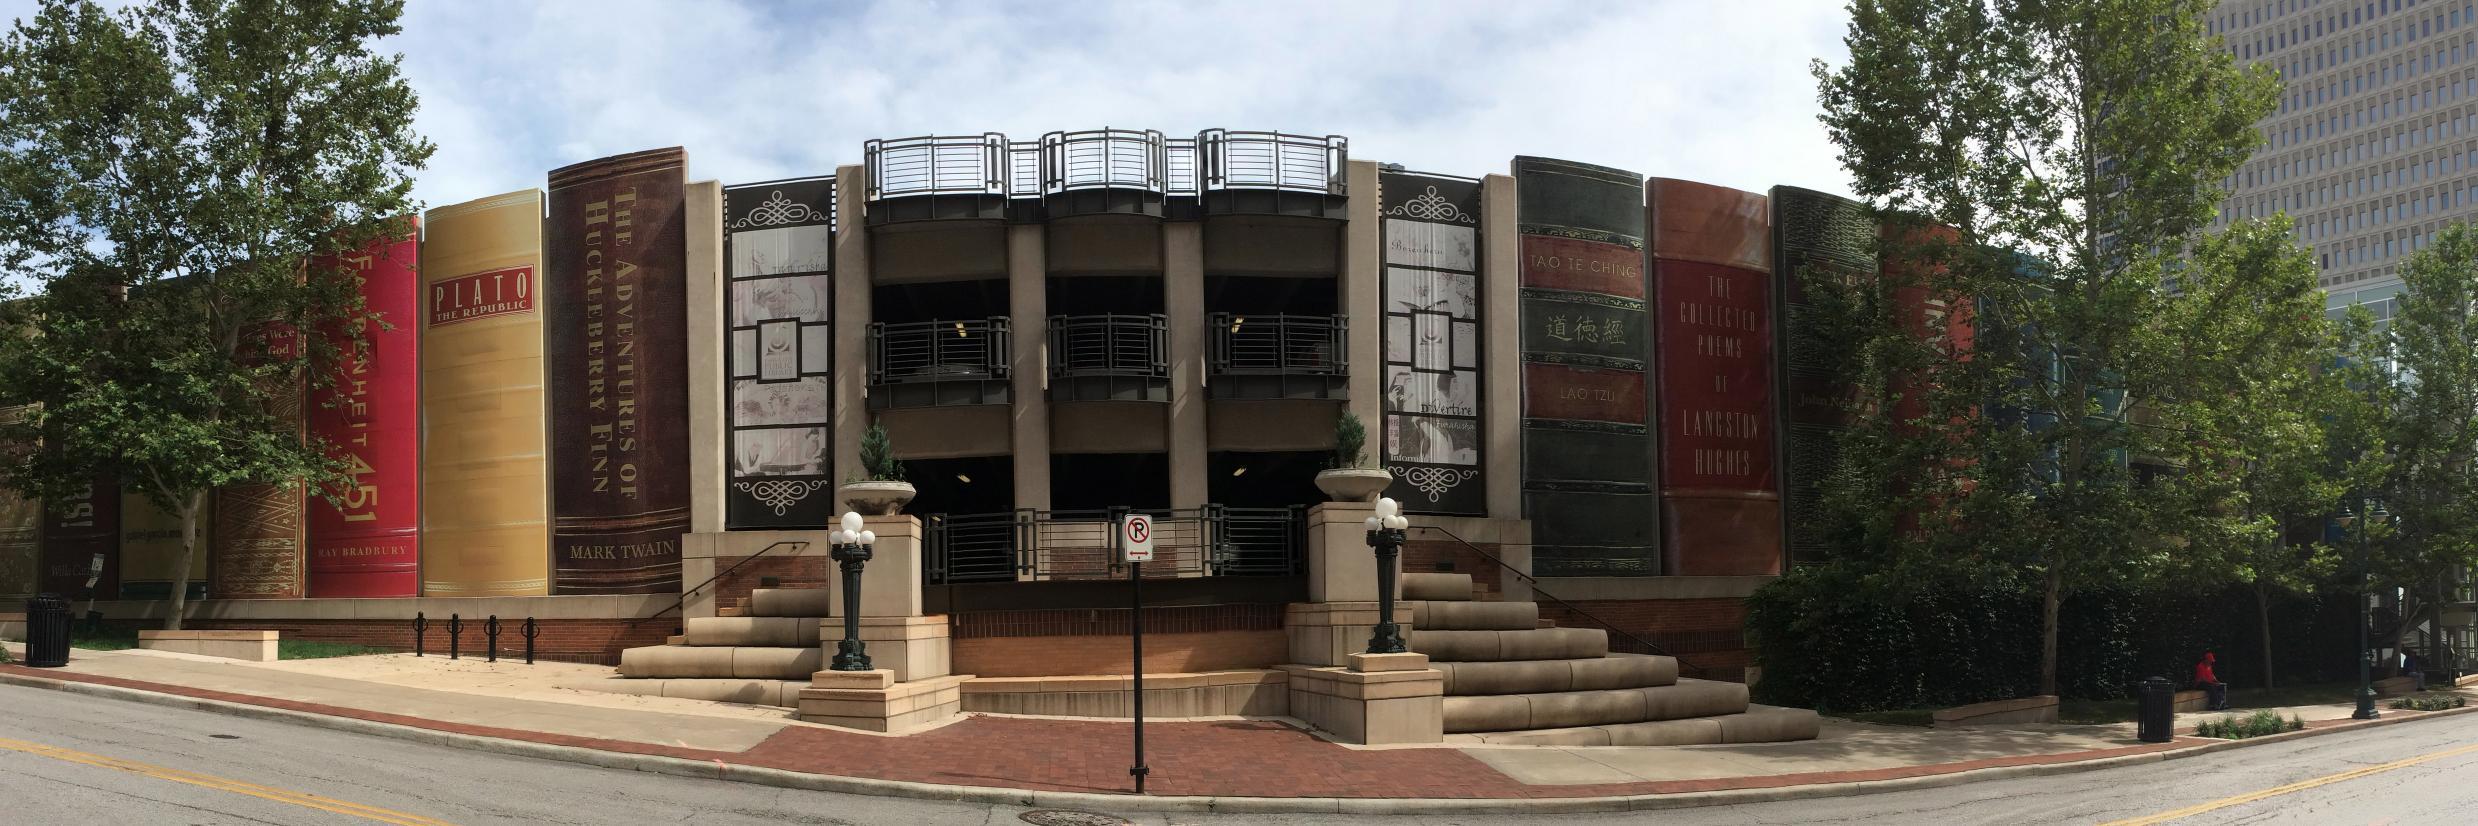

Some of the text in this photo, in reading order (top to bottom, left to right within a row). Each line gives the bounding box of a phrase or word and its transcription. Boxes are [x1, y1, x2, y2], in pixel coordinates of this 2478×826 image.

[1530, 254, 1637, 278] TAO TE CHING
[436, 272, 527, 312] PLATO
[1708, 275, 1732, 300] THE
[436, 299, 527, 322] THE REPUBLIC
[1680, 301, 1756, 333] COLLECTED
[267, 343, 289, 356] God
[585, 200, 613, 493] HUCKLEBERRY FINN
[614, 186, 639, 500] THE ADVENTURES OF
[1697, 334, 1743, 359] POEMS
[1560, 385, 1615, 402] LAO TZU
[1714, 374, 1729, 393] OF
[1683, 409, 1759, 441] LANGSTON
[1695, 448, 1751, 477] HUGHES
[344, 452, 378, 522] 451
[317, 545, 408, 559] RAY BRADBURY
[570, 539, 676, 560] MARK TWAIN
